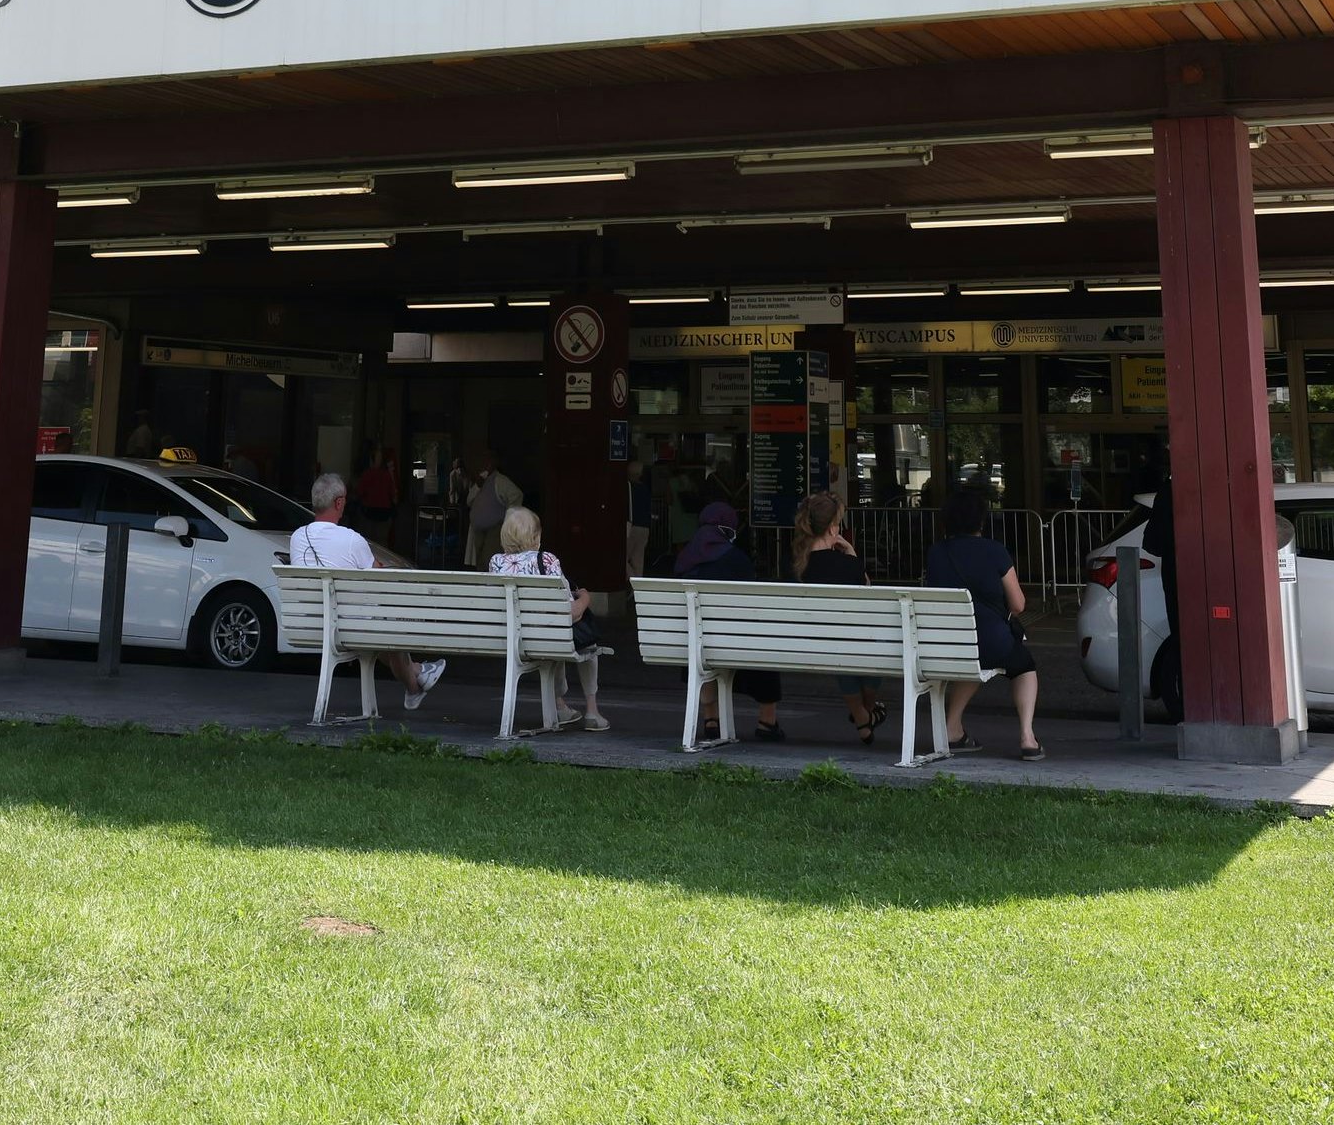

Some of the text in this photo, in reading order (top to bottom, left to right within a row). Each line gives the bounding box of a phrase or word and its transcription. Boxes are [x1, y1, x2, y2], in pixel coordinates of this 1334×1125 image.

[1018, 325, 1078, 334] MEDIZINISCHE
[640, 332, 763, 347] MEDIZINISCHER
[1018, 333, 1097, 343] UNIVERSITÄT WIEN
[226, 353, 282, 369] Michelbeuern
